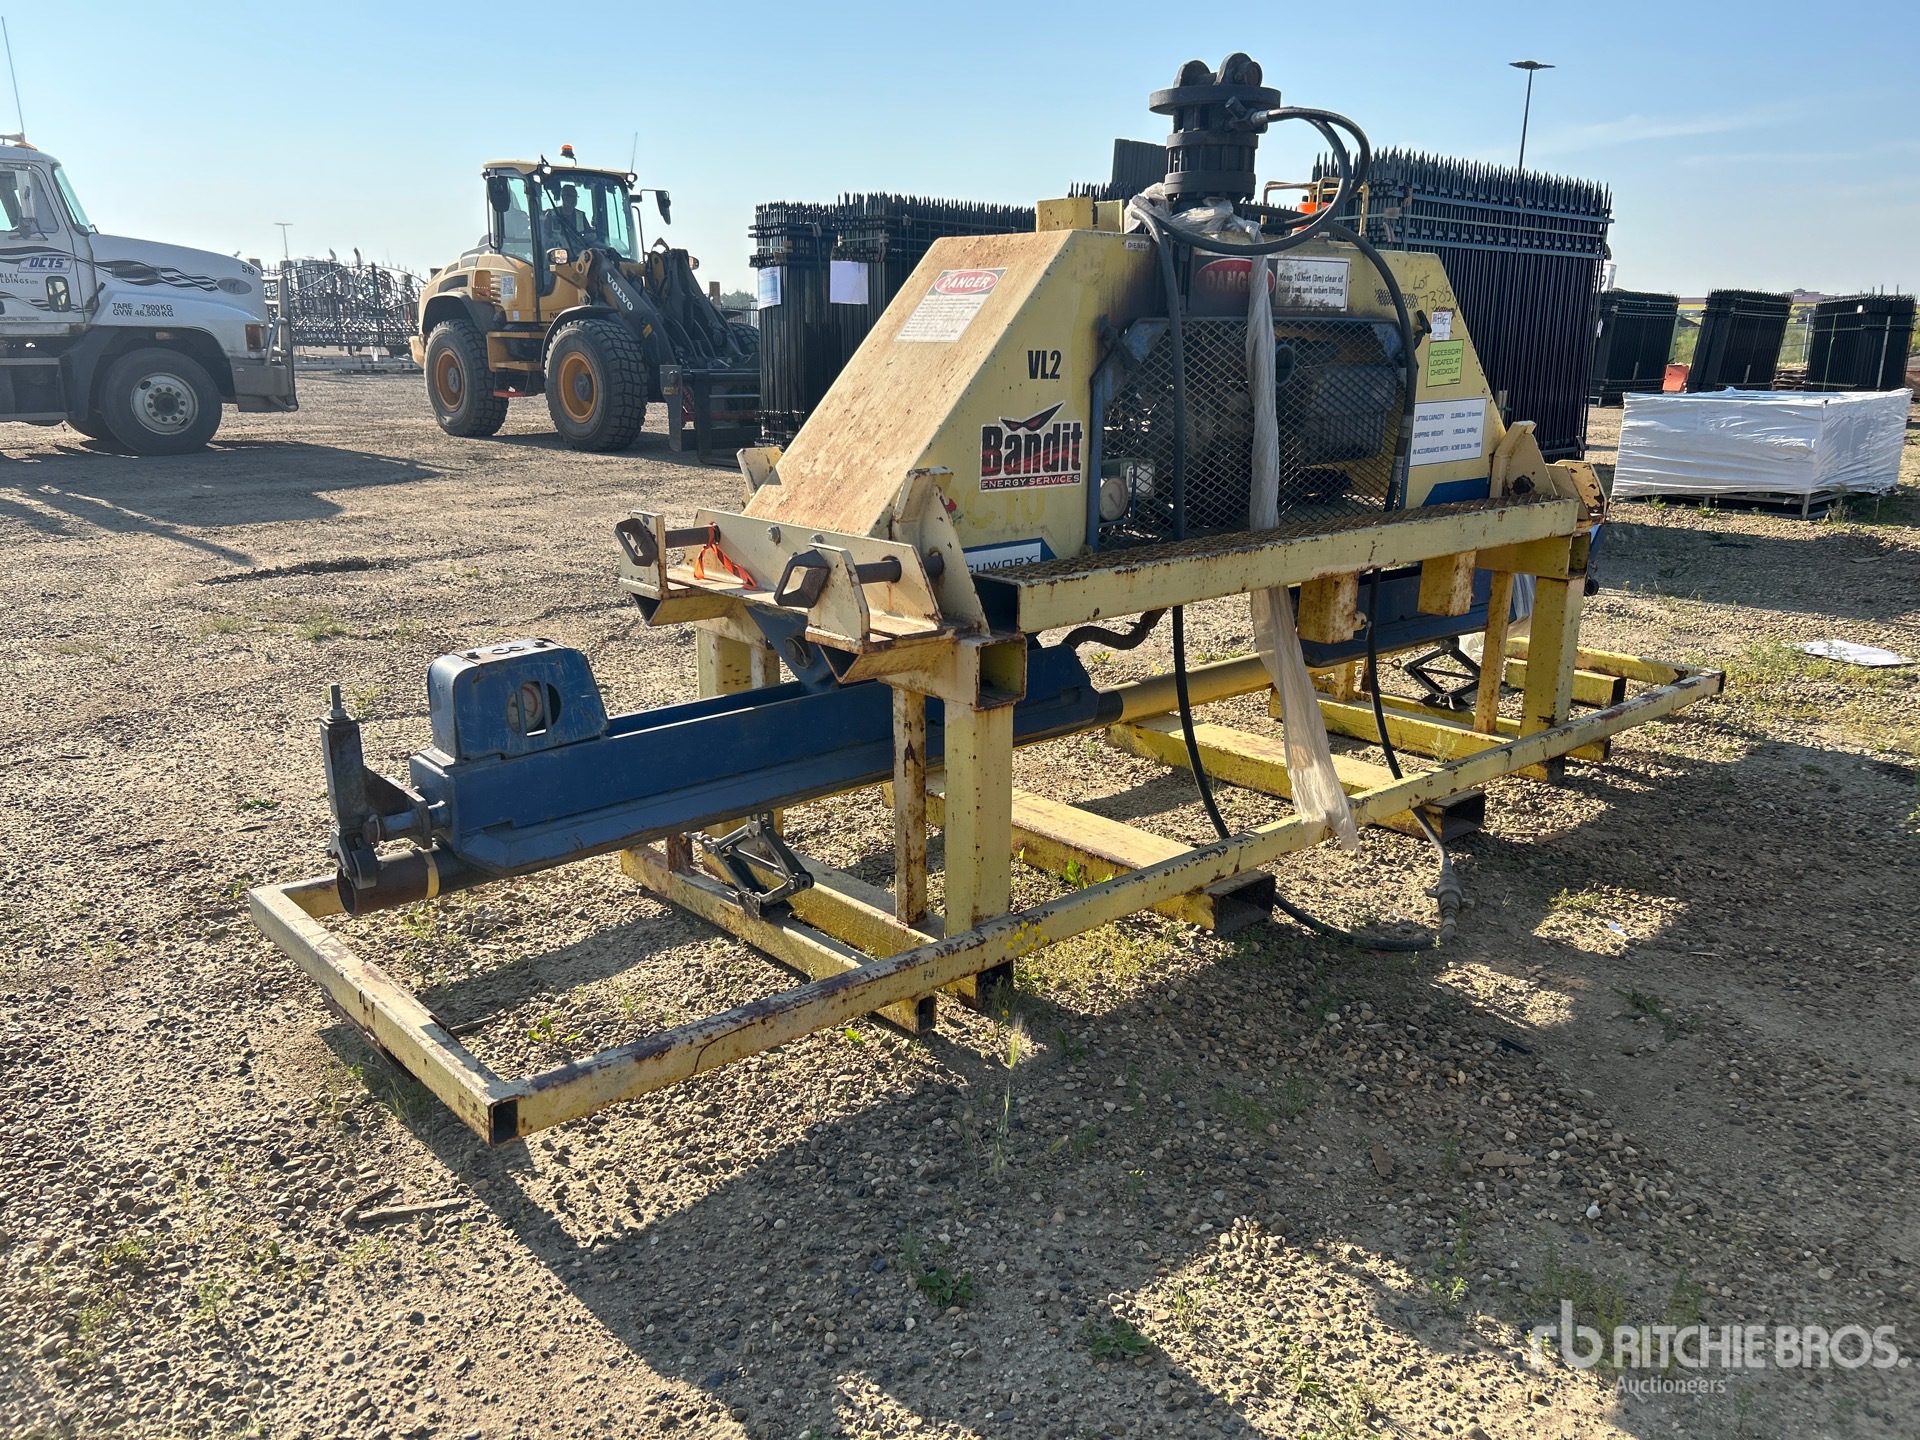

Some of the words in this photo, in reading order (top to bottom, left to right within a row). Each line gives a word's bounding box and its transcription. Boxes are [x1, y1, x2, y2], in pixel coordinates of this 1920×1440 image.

[29, 257, 64, 268] OCTS
[242, 264, 255, 276] 519
[942, 276, 991, 289] DANGER
[1325, 275, 1337, 283] clear
[1338, 275, 1344, 283] of
[606, 272, 634, 311] VOLVO
[1430, 348, 1461, 357] ACCESSORY
[1027, 350, 1061, 379] VL2
[1430, 358, 1454, 367] LOCATED
[1430, 367, 1459, 376] CHECKOUT
[982, 422, 1082, 476] Bandit
[982, 478, 1027, 488] ENERGY
[1028, 475, 1080, 485] SERVICES
